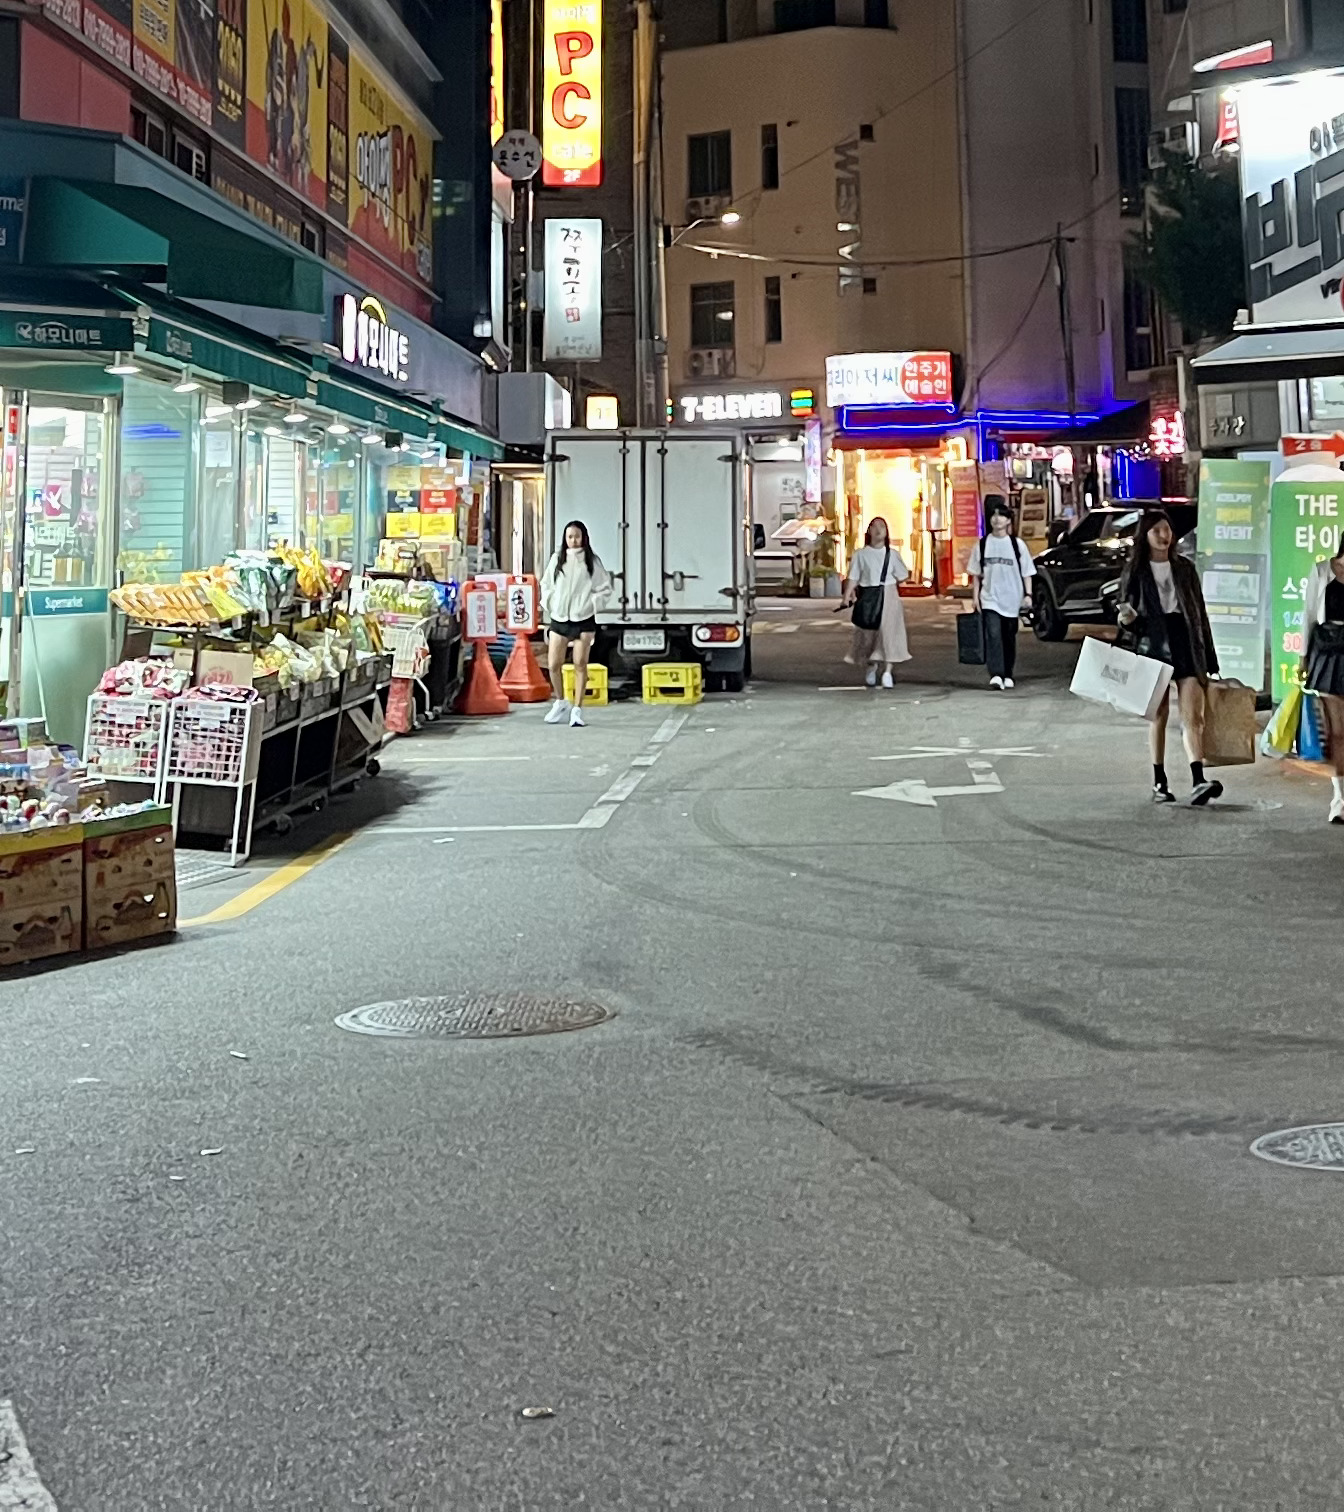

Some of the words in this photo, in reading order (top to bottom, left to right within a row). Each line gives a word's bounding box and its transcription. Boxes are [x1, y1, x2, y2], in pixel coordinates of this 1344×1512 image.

[33, 324, 103, 346] 하모니마트
[904, 360, 948, 377] 안주가
[904, 378, 948, 395] 예술인
[680, 390, 783, 422] 7-ELEVEN
[1294, 494, 1339, 517] THE
[1214, 525, 1254, 541] EVENT
[1295, 524, 1340, 553] 타이
